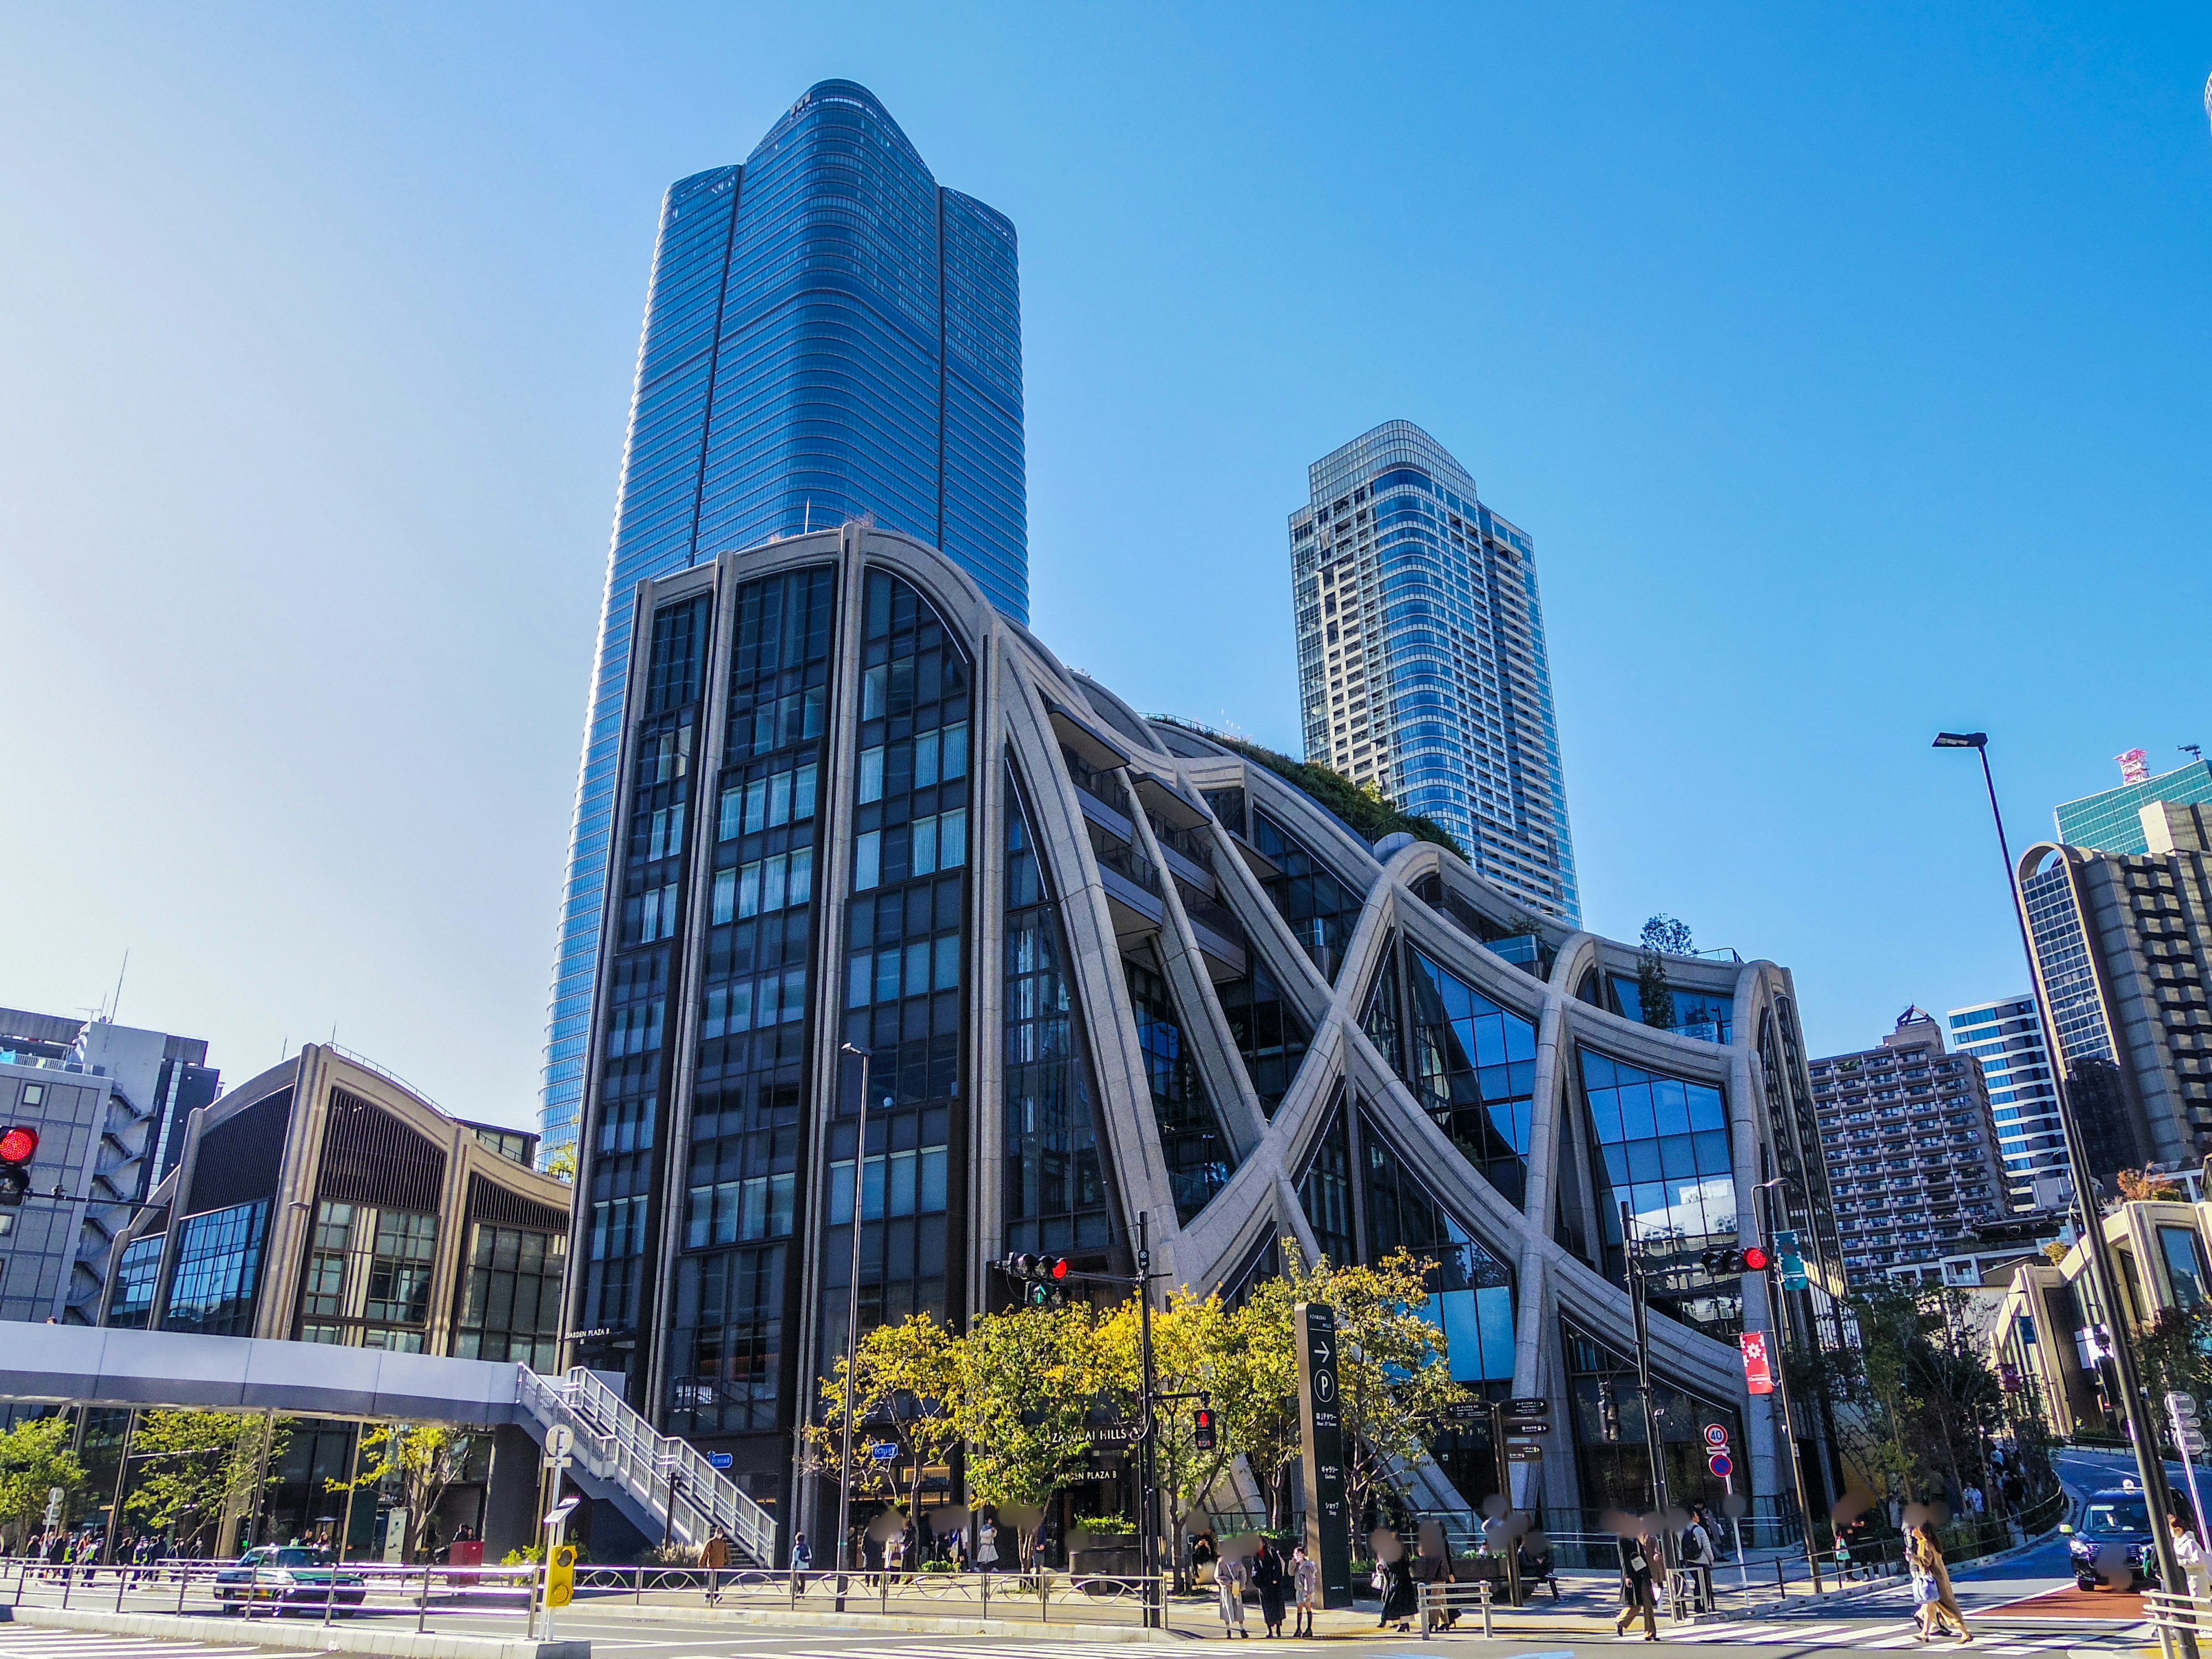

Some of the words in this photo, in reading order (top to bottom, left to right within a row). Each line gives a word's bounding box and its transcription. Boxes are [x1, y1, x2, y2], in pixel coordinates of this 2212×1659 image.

[566, 1331, 586, 1339] GARDEN
[588, 1328, 605, 1336] PLAZA
[1321, 1376, 1328, 1396] P
[1711, 1430, 1722, 1440] 40
[1087, 1471, 1110, 1480] PLAZA
[1112, 1470, 1116, 1478] B
